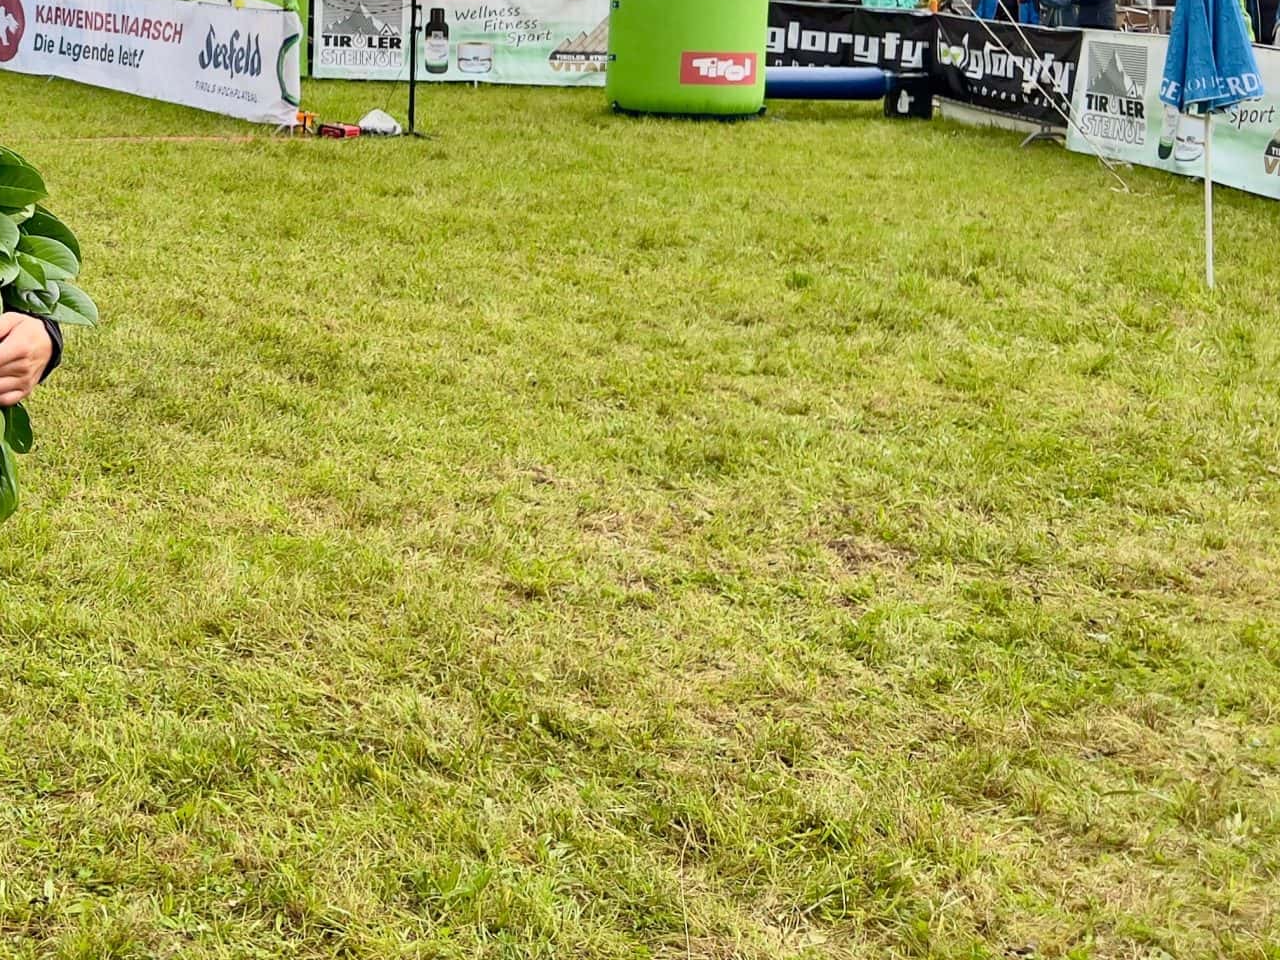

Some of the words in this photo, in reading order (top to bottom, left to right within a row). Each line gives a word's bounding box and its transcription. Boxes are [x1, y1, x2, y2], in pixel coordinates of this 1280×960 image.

[454, 5, 521, 22] Wellness
[483, 18, 538, 32] Fitness
[33, 33, 56, 54] Die
[58, 36, 115, 64] Legende
[321, 31, 402, 49] TIROLER
[506, 30, 552, 45] Sport
[766, 21, 924, 69] gloryfy
[321, 47, 402, 67] STEINÖL
[692, 55, 752, 81] Tirol
[964, 40, 1071, 95] gloryfy
[1085, 93, 1145, 120] TIROLER
[1080, 112, 1146, 146] STEINÖL
